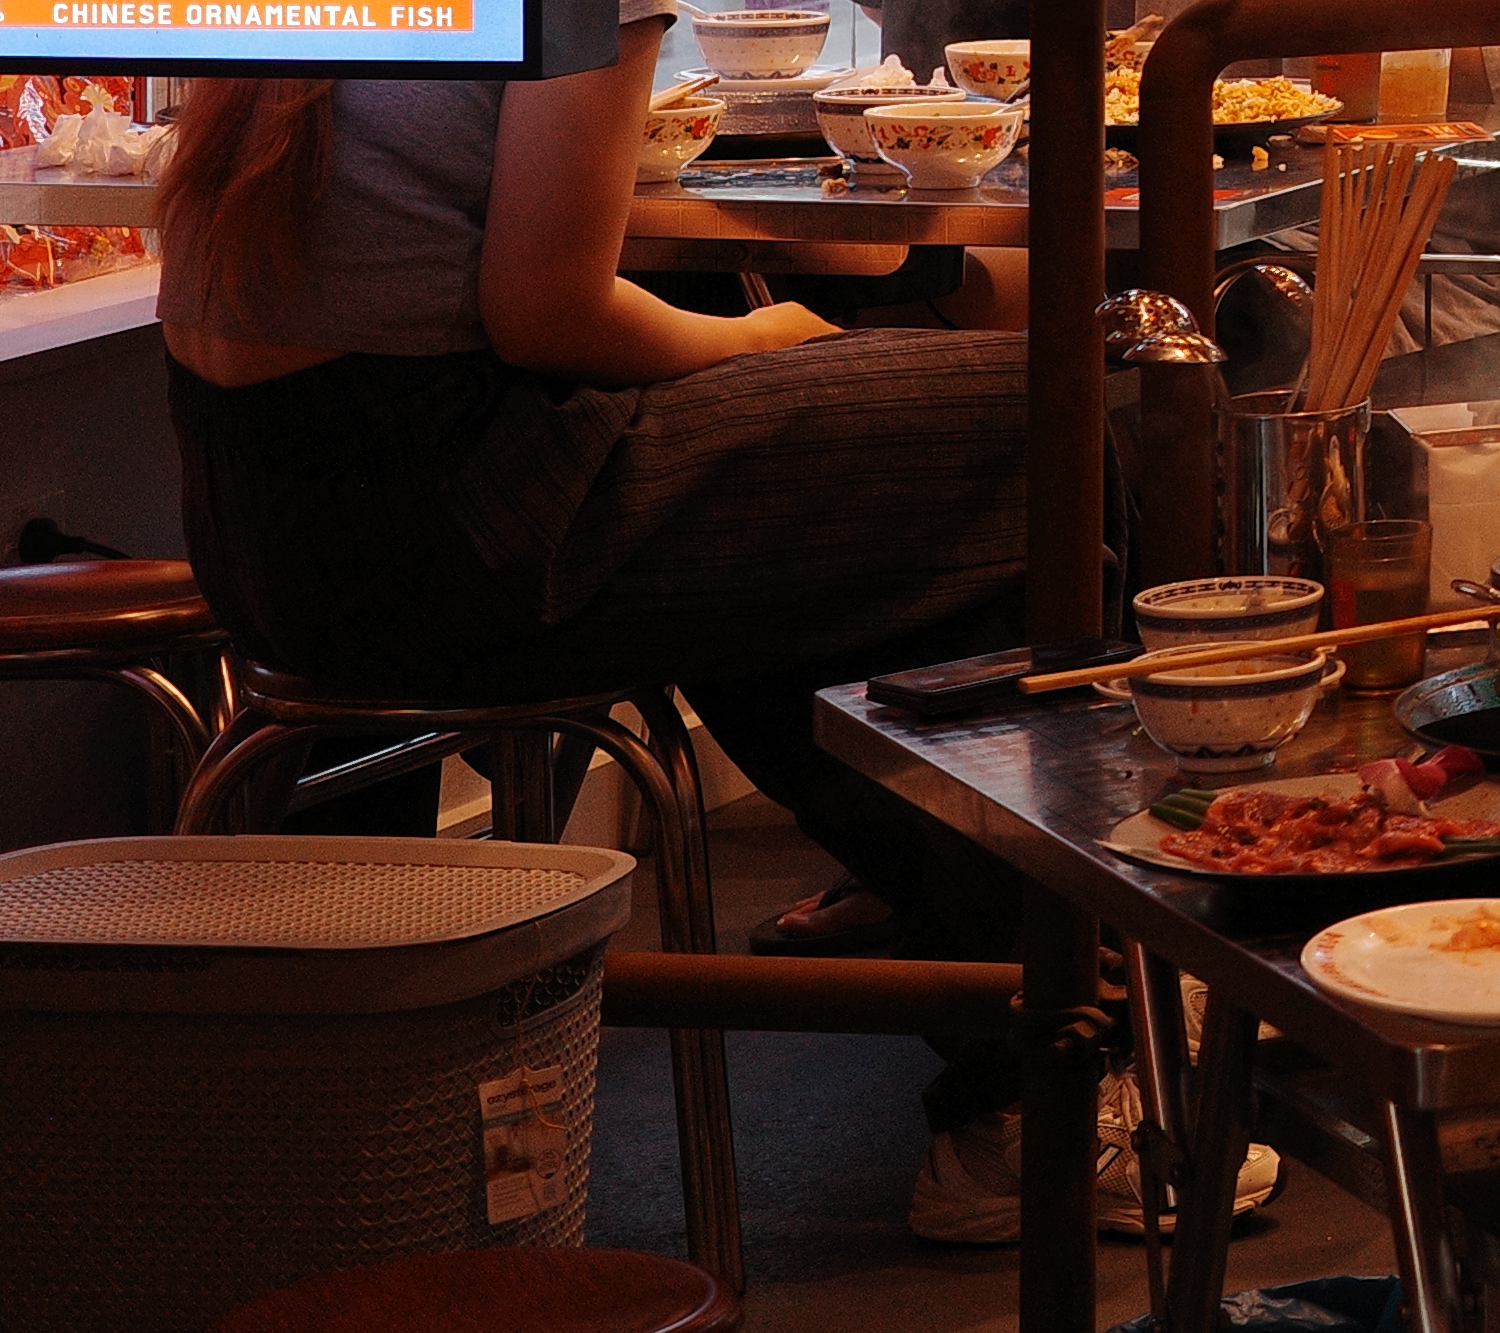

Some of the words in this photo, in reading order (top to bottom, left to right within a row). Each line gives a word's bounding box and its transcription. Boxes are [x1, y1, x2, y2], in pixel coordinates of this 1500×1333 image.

[52, 3, 173, 26] CHINESE
[184, 3, 379, 30] ORNAMENTAL
[389, 5, 455, 28] FISH
